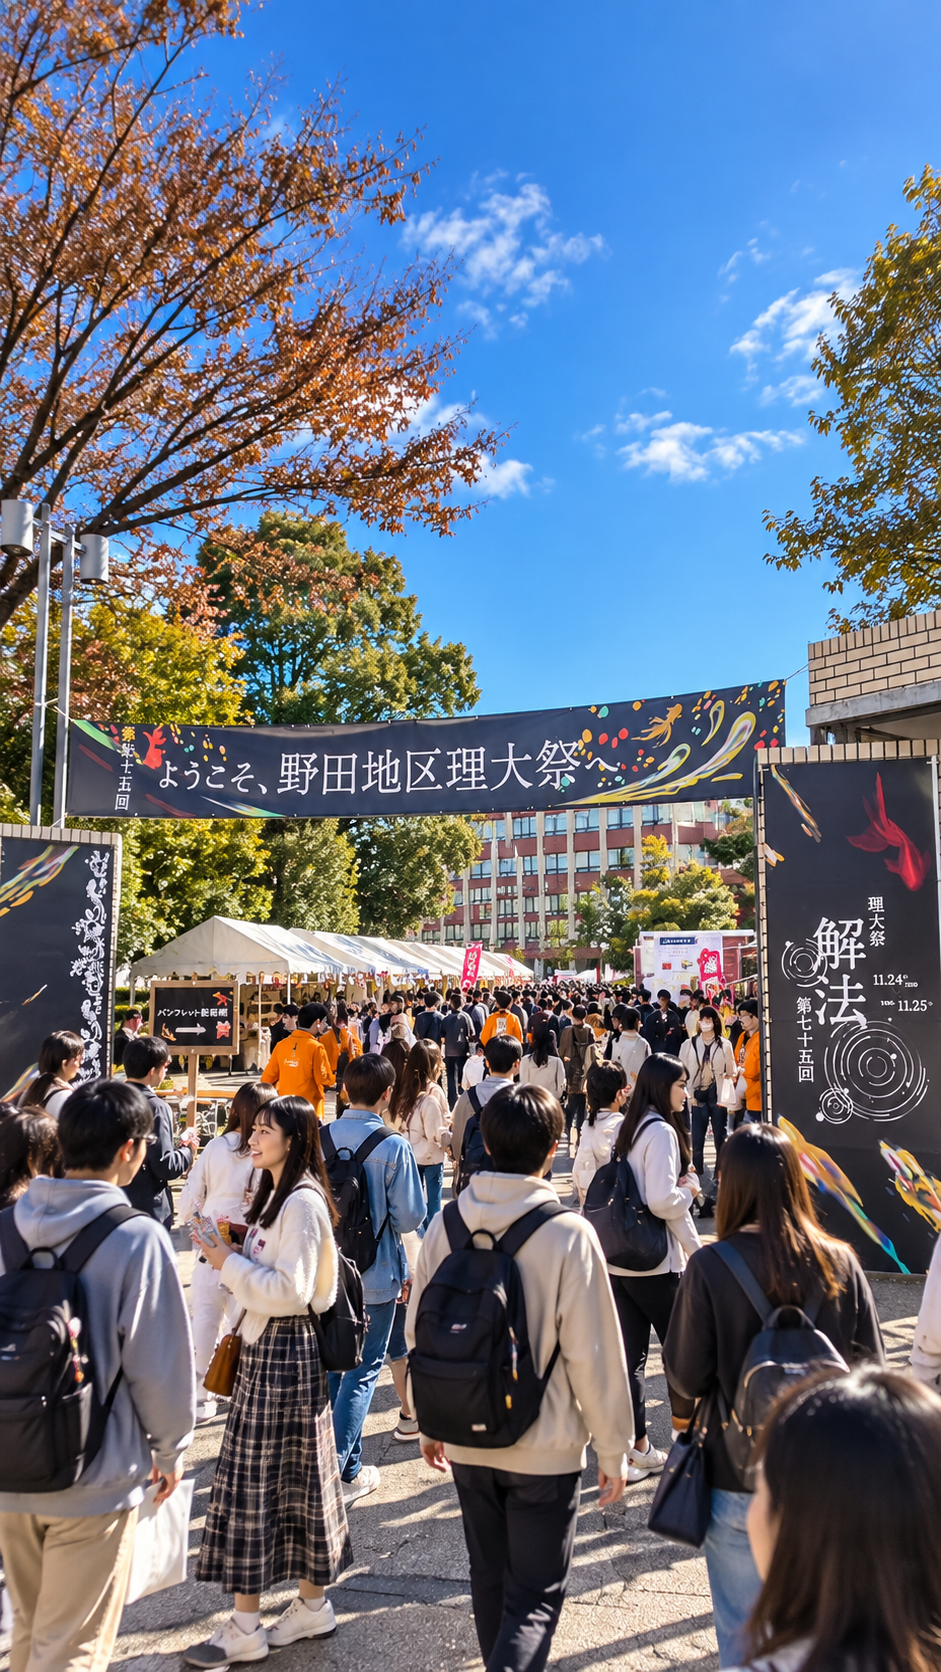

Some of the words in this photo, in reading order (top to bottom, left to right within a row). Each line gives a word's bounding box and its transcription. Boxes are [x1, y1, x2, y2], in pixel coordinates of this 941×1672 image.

[159, 739, 619, 796] ようこそ、野田地区理大祭へ
[867, 896, 886, 947] 理大祭
[812, 916, 867, 1030] 解法
[873, 974, 903, 986] 11.24
[898, 999, 928, 1012] 11.25
[796, 996, 814, 1083] 第七十五回
